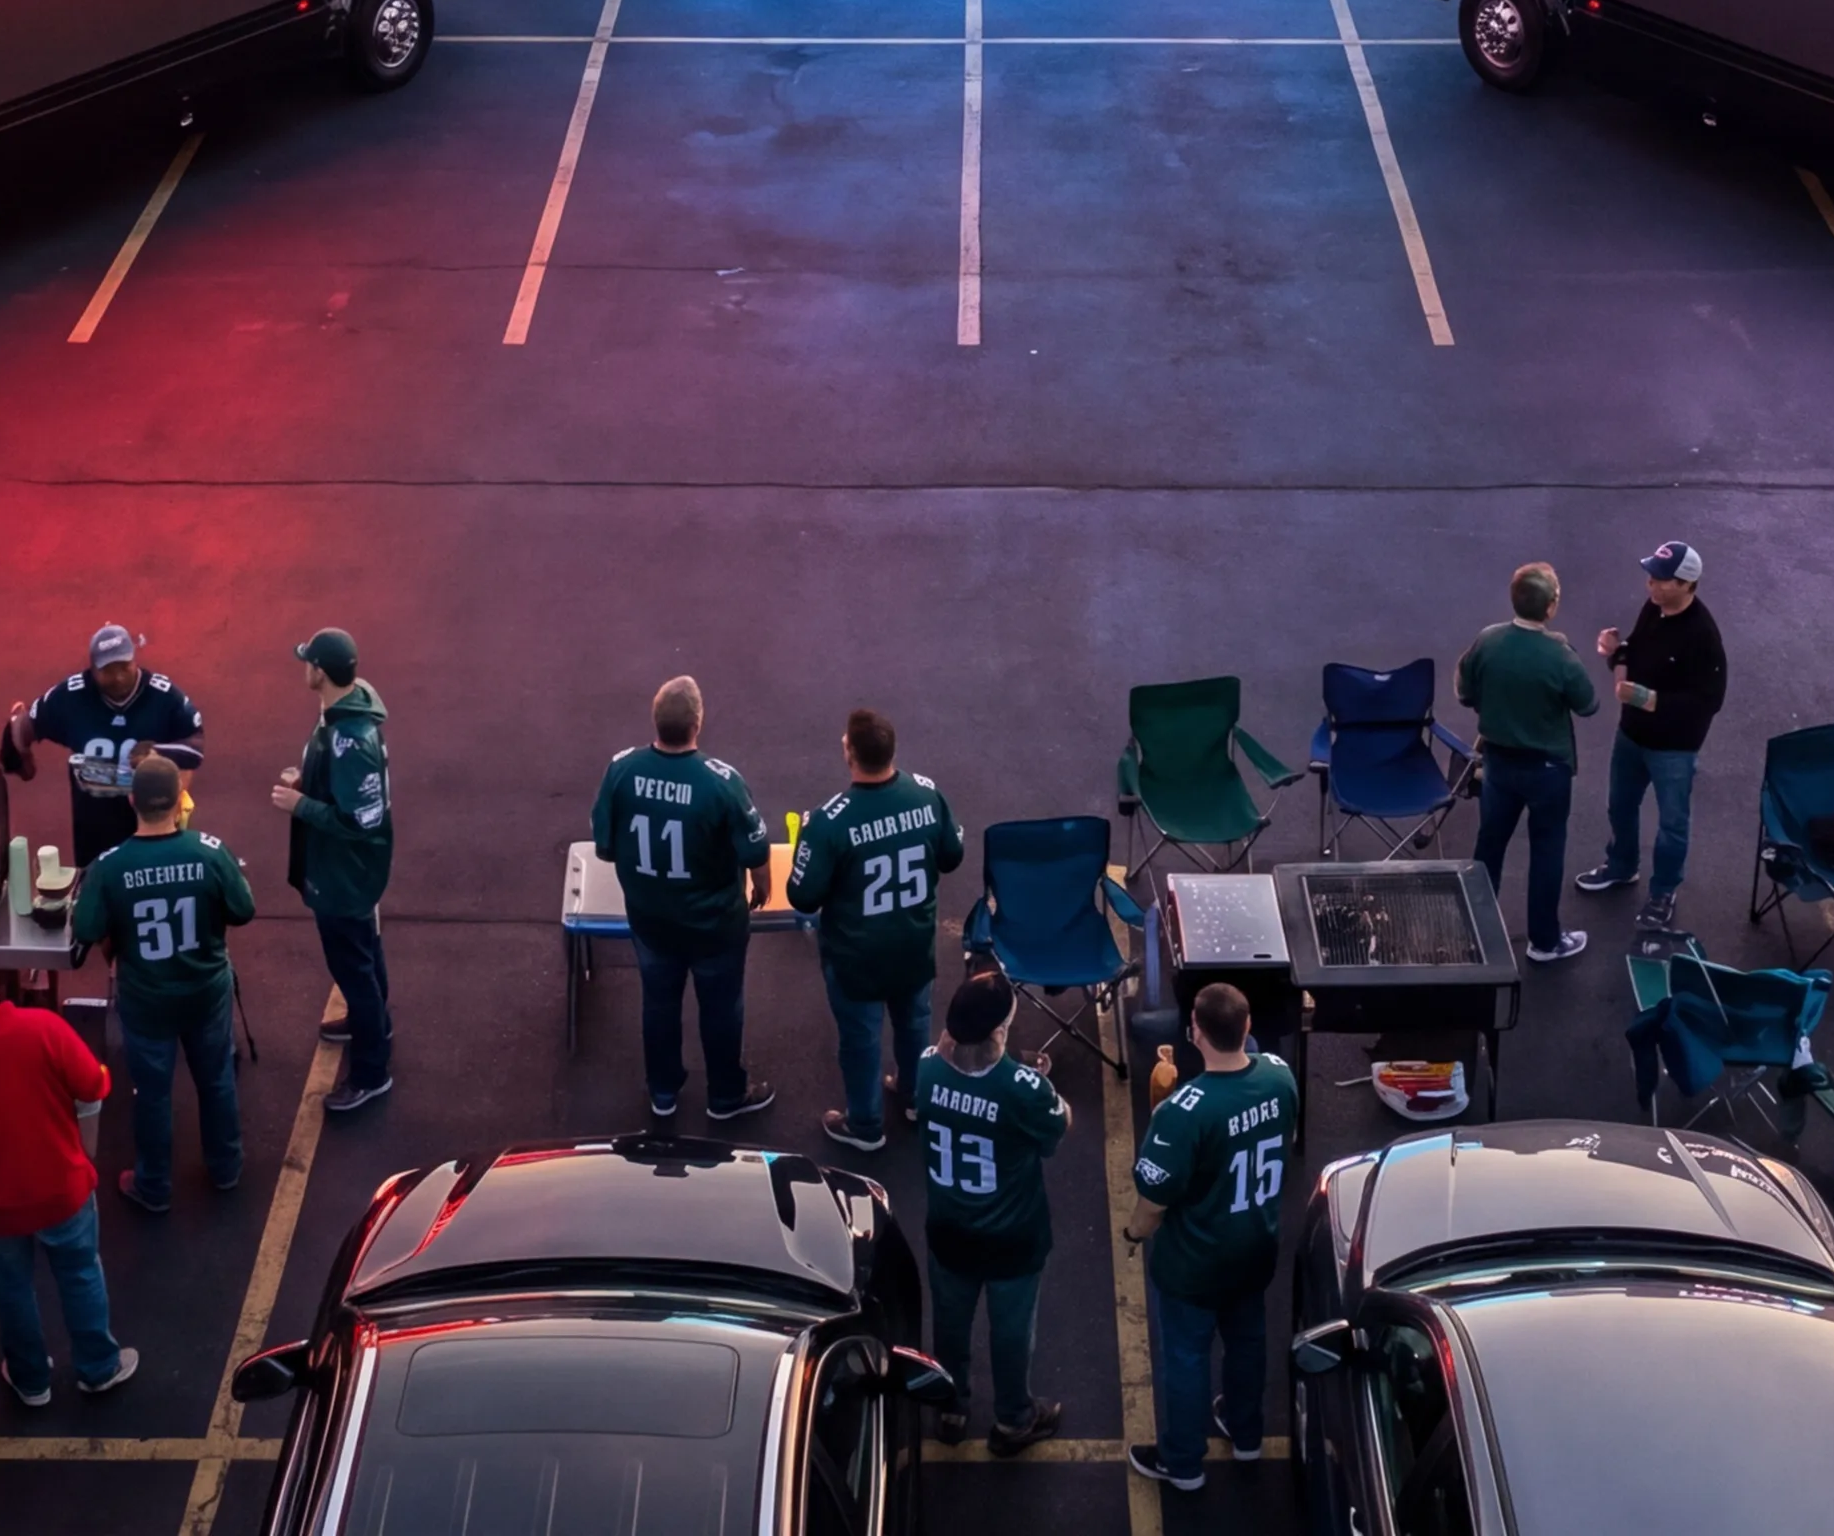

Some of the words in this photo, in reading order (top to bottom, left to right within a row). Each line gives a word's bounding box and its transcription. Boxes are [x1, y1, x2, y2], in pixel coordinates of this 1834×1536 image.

[630, 814, 692, 879] 11
[863, 844, 928, 916] 25
[133, 896, 200, 961] 31
[928, 1120, 997, 1194] 33
[1229, 1134, 1283, 1214] 15
